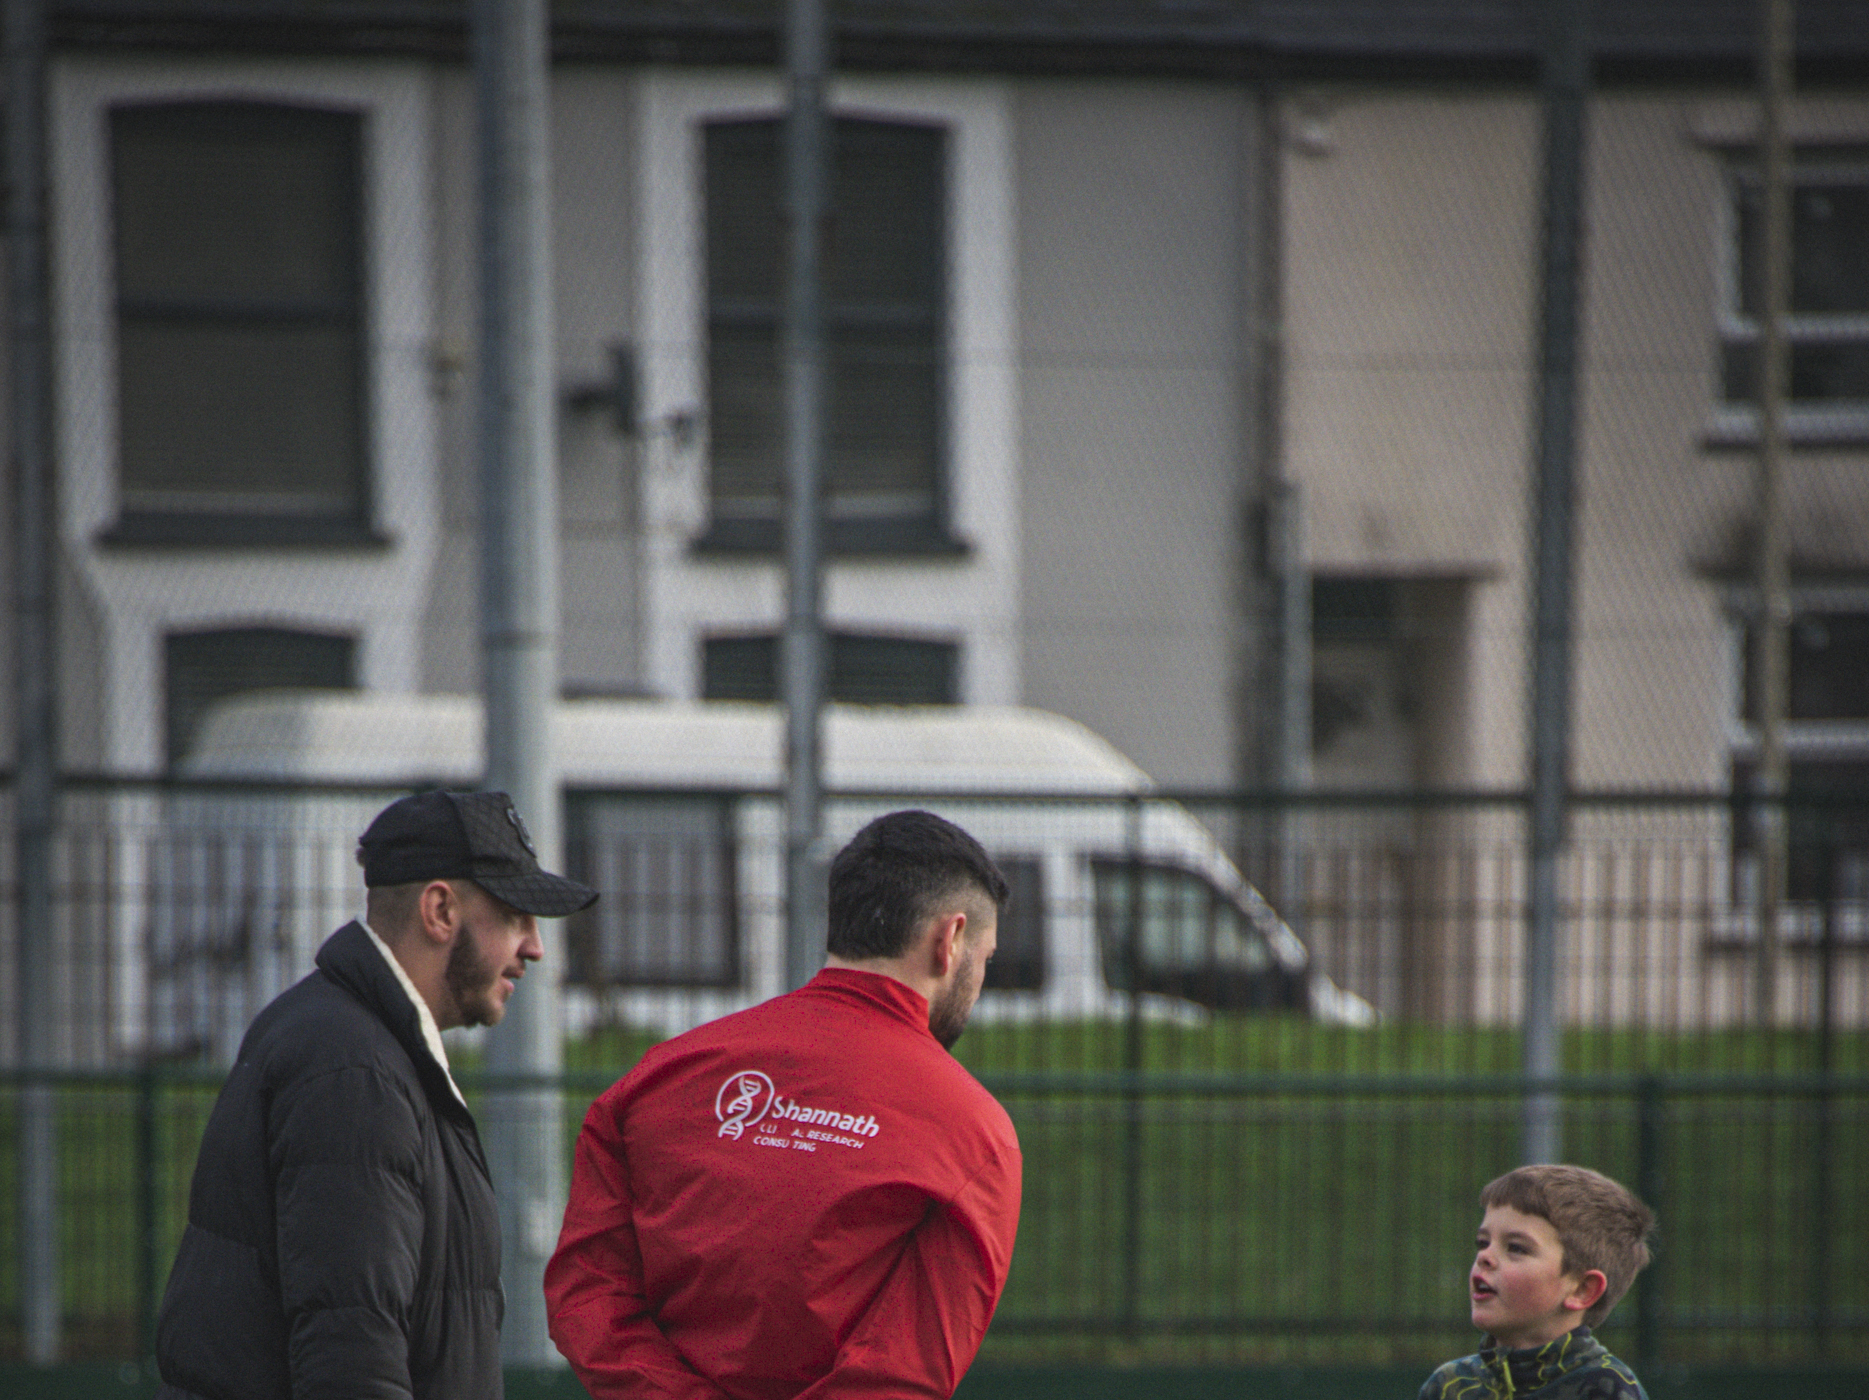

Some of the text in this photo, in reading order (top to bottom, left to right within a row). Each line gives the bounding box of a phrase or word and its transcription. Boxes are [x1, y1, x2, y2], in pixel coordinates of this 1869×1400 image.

[772, 1096, 880, 1138] Shannath
[753, 1136, 817, 1152] CONSUTING
[807, 1130, 865, 1149] RESEARCH
